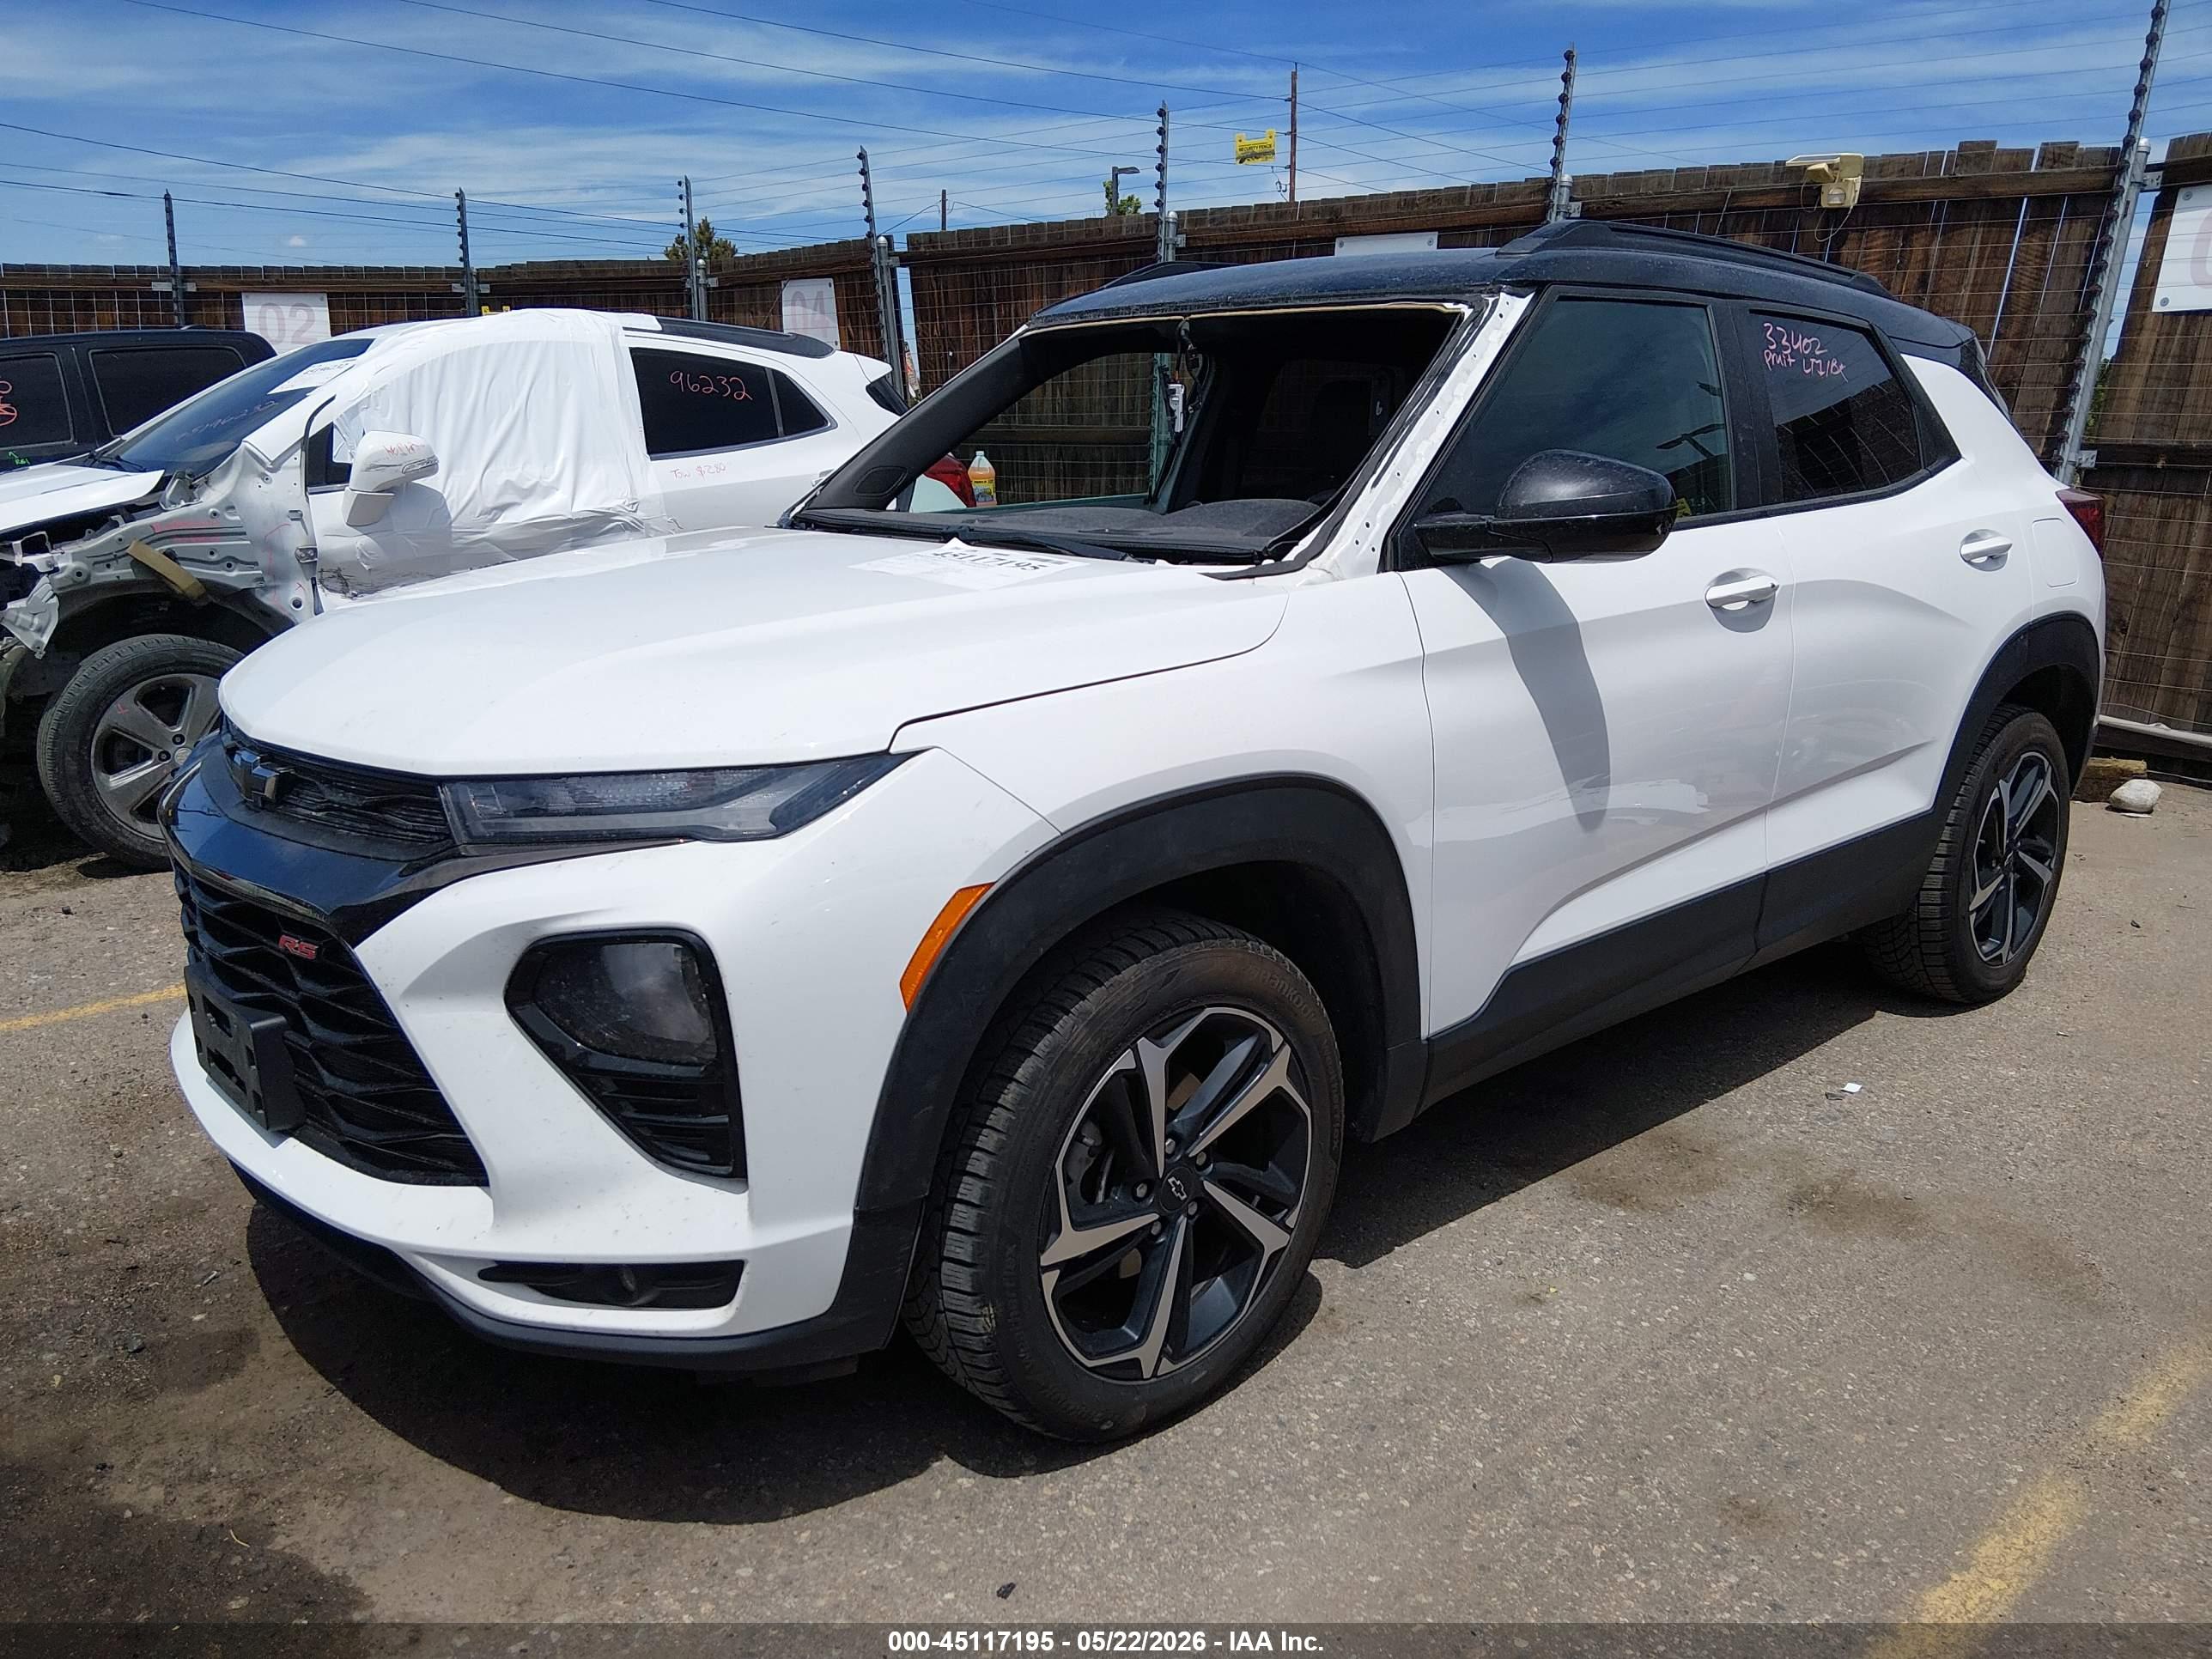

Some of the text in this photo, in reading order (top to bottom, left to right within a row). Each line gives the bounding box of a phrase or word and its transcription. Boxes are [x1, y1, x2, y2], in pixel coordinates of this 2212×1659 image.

[258, 303, 316, 344] 02
[1763, 322, 1828, 355] 33402
[670, 370, 753, 400] 96232
[278, 934, 319, 960] RS
